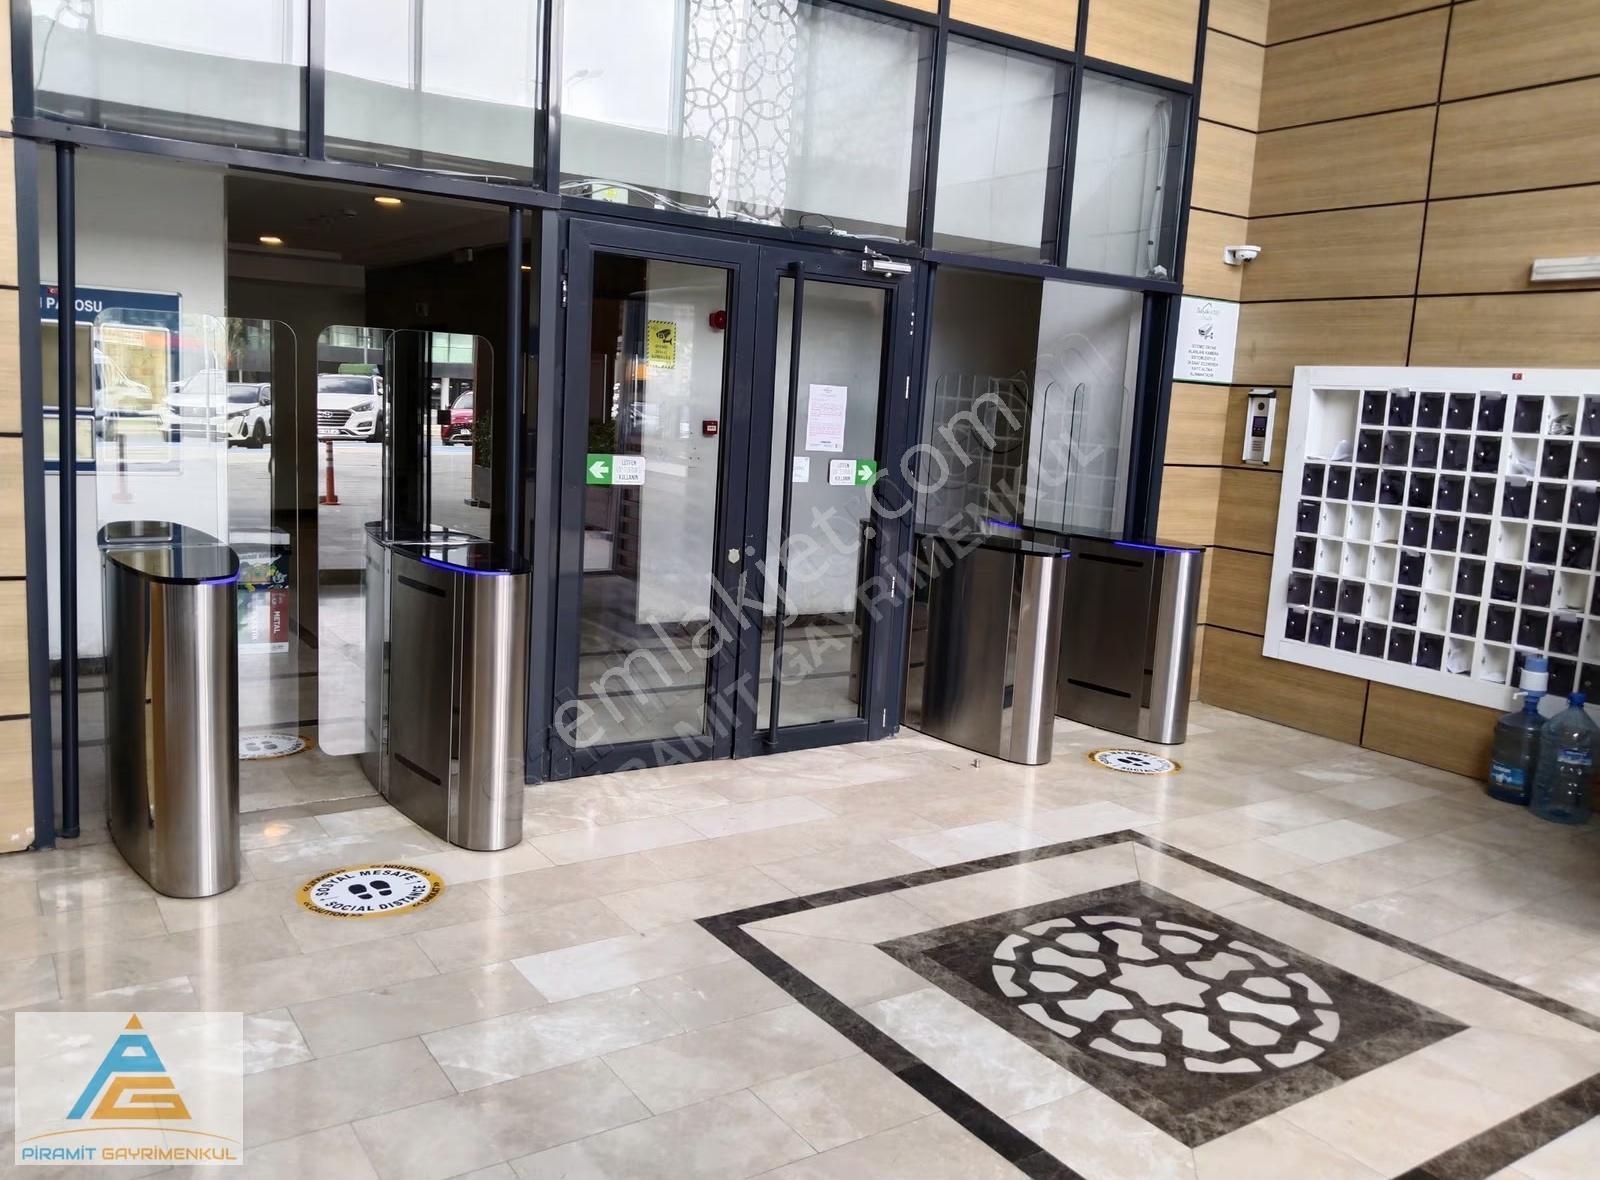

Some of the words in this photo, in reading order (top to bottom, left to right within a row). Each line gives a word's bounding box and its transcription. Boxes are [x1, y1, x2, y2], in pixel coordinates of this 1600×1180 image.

[46, 297, 102, 312] POSU
[273, 610, 281, 634] METAL
[316, 873, 355, 897] SOSYAL
[359, 869, 418, 881] MESAFE
[325, 901, 375, 912] SOCIAL
[379, 884, 426, 910] DISTANCE
[308, 904, 349, 918] CAUTION
